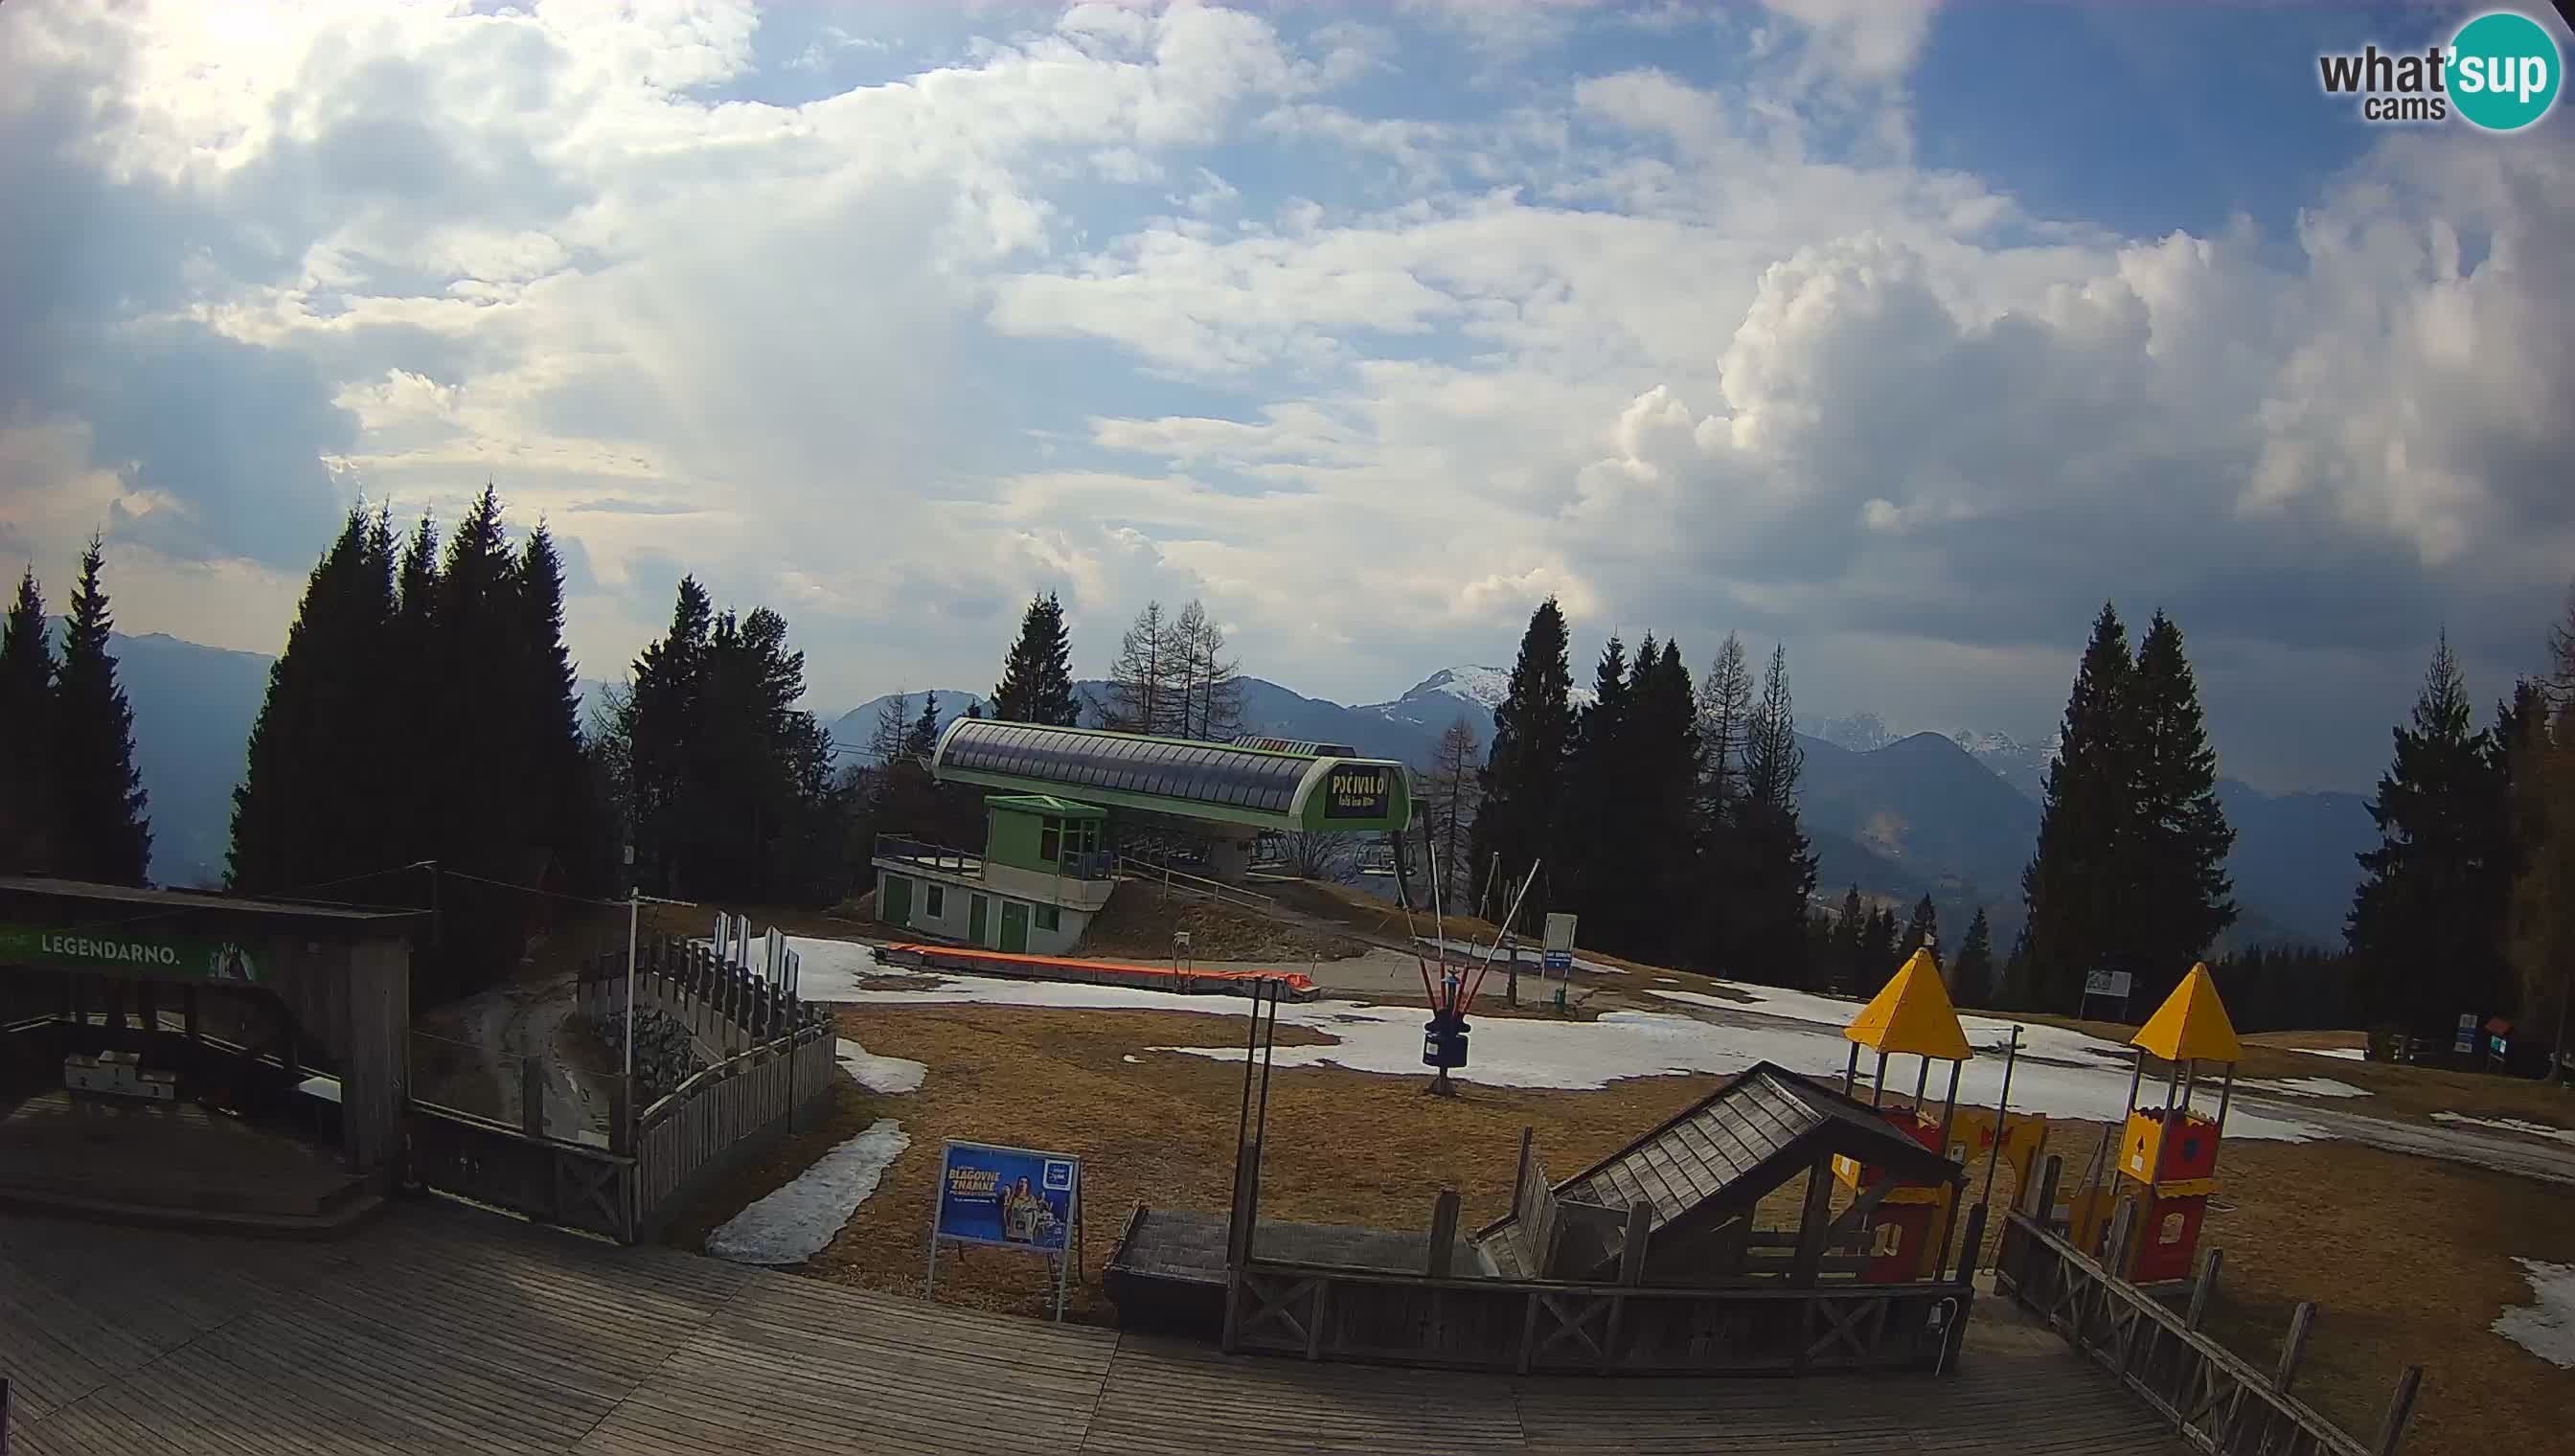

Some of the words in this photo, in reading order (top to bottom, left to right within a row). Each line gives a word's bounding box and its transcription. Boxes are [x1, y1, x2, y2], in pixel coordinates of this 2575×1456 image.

[42, 934, 181, 965] LEGENDARNO.
[948, 1169, 1001, 1181] BLAGOVNE
[951, 1179, 995, 1192] ZNAMKE
